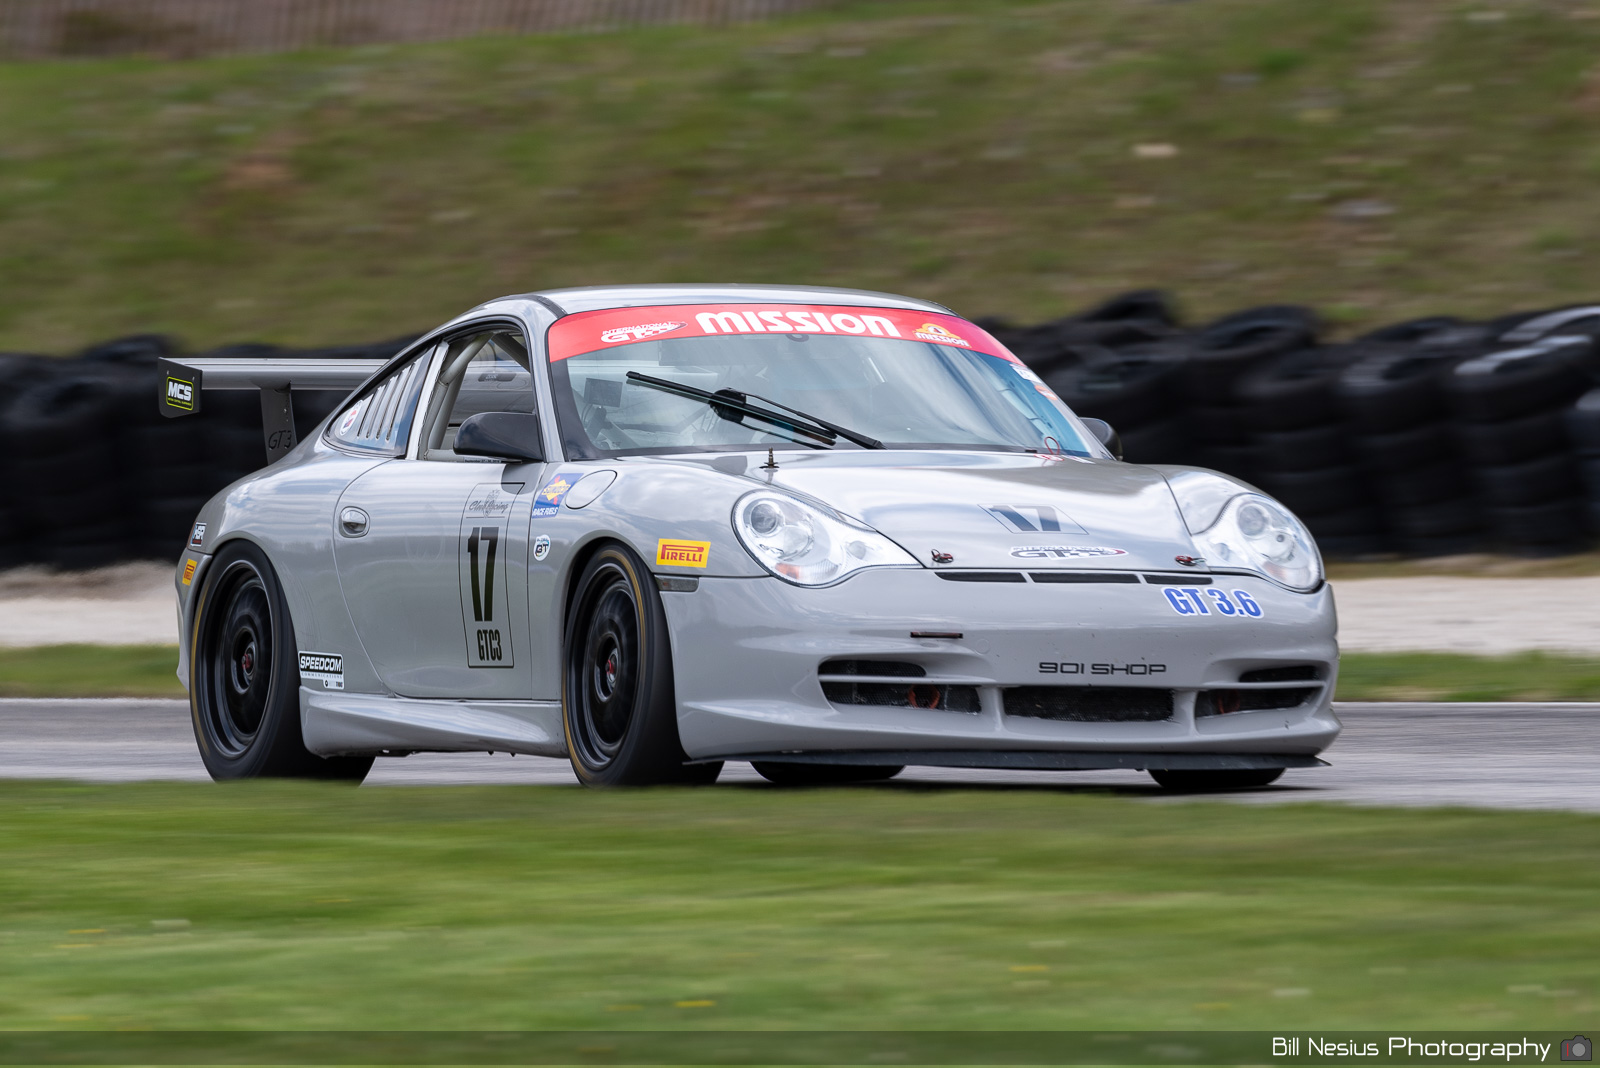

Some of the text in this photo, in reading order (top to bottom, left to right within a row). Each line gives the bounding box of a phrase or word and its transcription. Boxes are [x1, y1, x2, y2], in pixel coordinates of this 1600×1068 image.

[168, 381, 192, 401] MCS
[988, 504, 1061, 531] 17
[660, 544, 705, 563] PIRELLI
[467, 526, 499, 622] 17
[1162, 587, 1263, 618] GT 3.6
[476, 628, 503, 662] GTC3
[300, 655, 342, 672] SPEEDCOM
[1038, 662, 1167, 676] 901 SHOP
